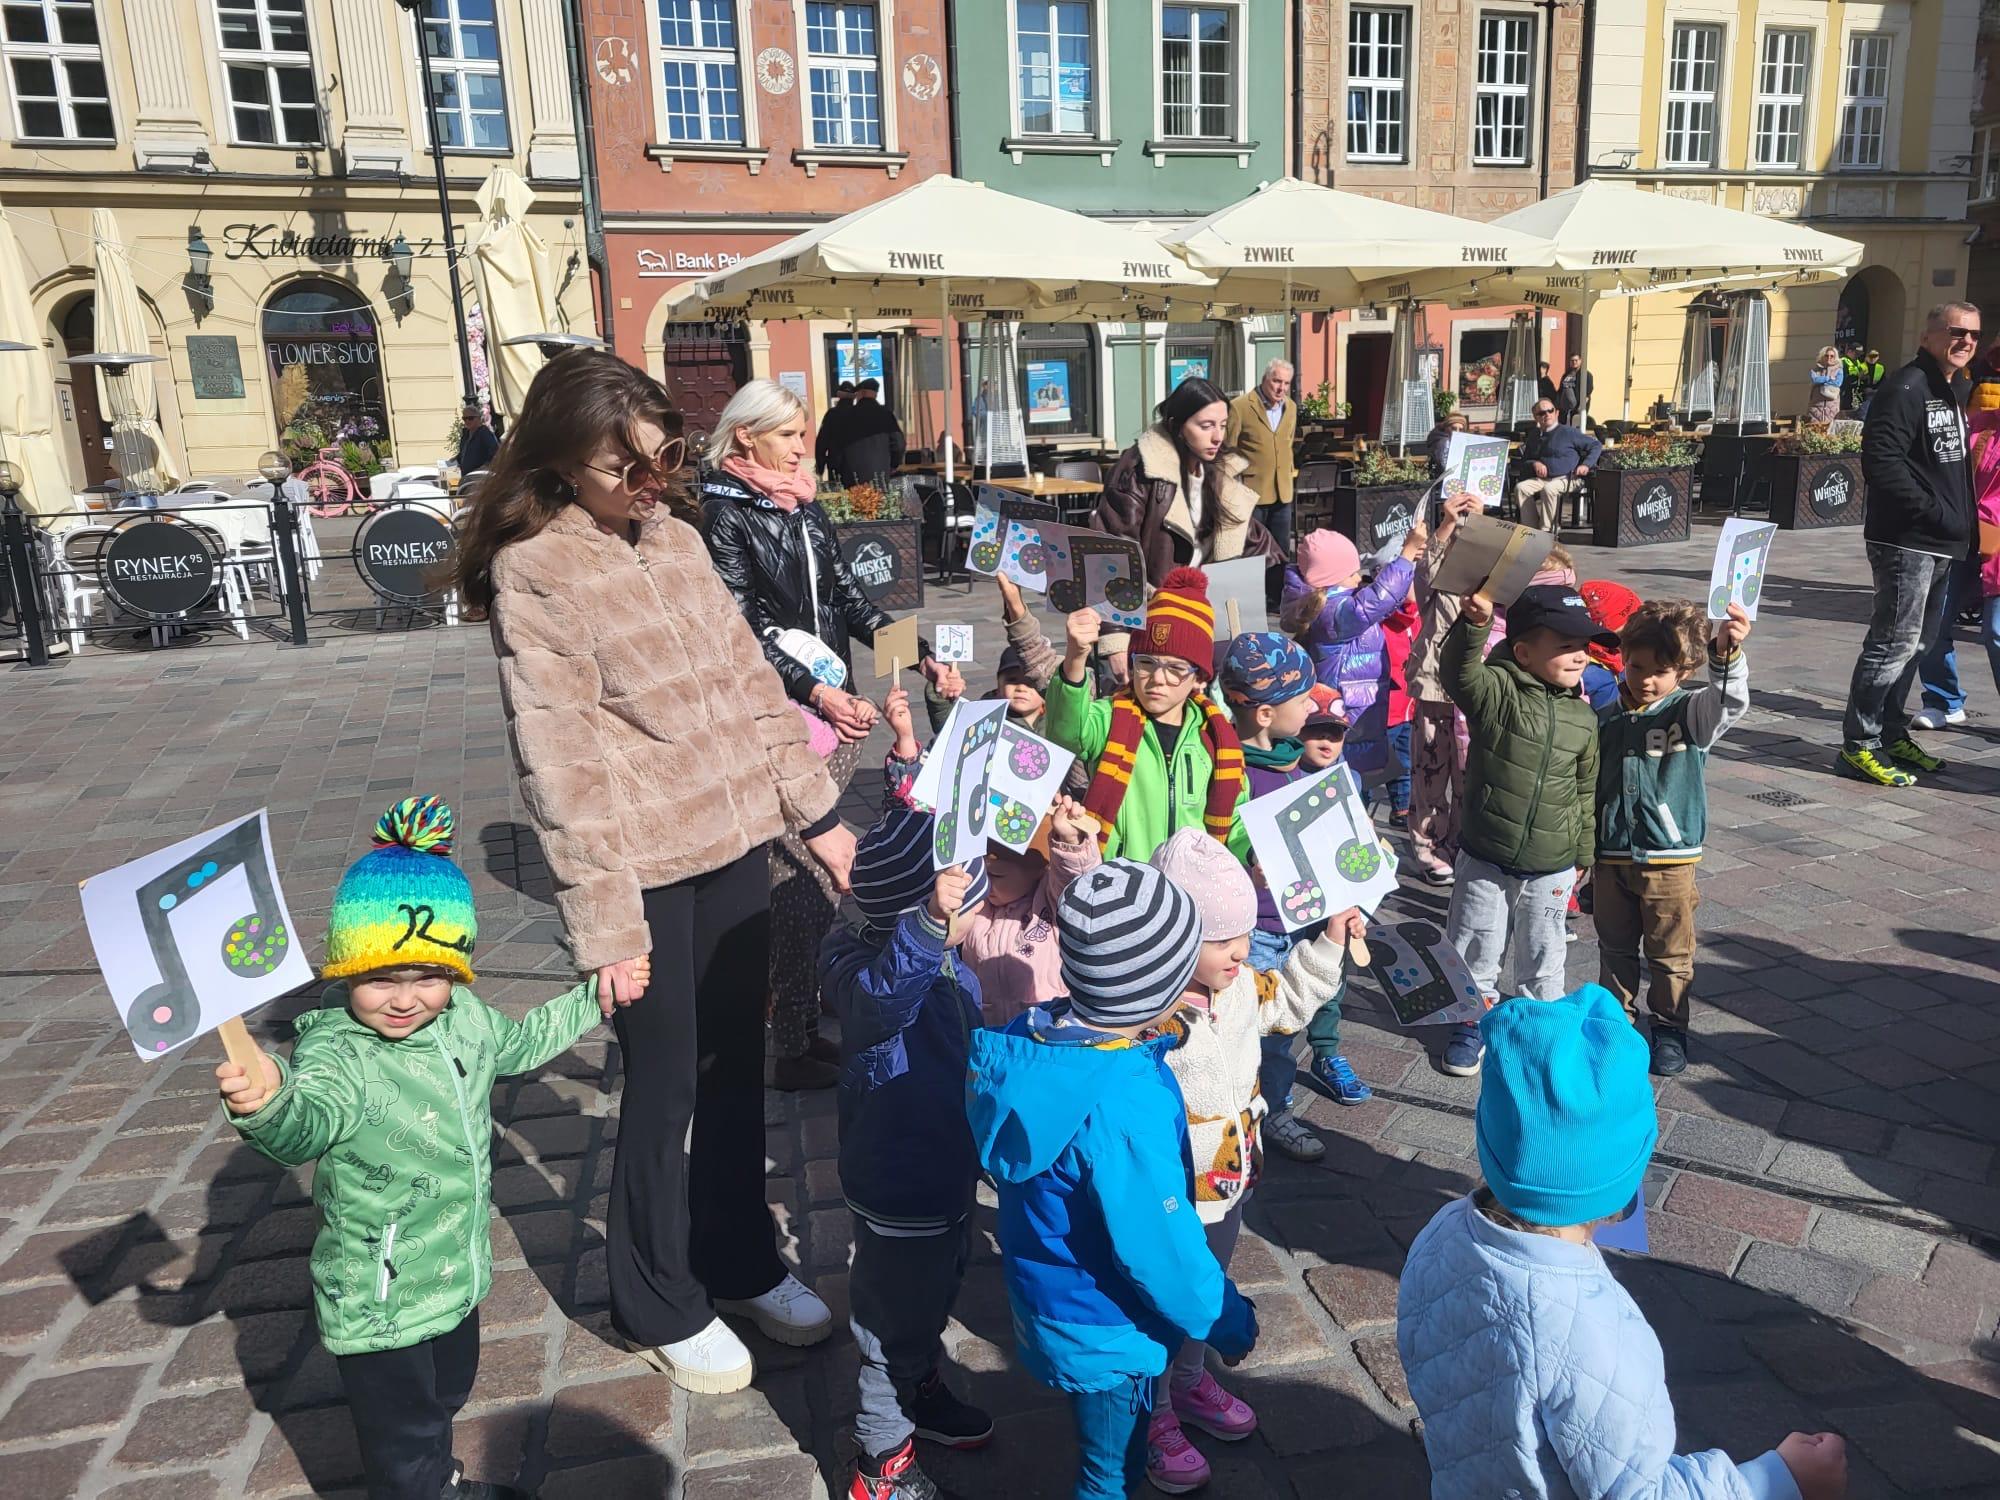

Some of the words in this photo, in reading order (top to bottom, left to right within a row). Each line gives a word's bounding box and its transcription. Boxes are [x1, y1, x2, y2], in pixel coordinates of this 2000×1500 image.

[675, 253, 715, 269] Bank
[888, 250, 945, 270] ŻYWIEC
[1244, 245, 1295, 262] ŻYWIEC
[1462, 245, 1508, 262] ŻYWIEC
[1592, 250, 1638, 265] ŻYWIEC
[1783, 247, 1824, 262] ŻYWIEC
[1122, 261, 1172, 278] ŻYWIEC
[1523, 290, 1561, 307] ŻYWIEC
[267, 342, 336, 364] FLOWER
[338, 342, 378, 364] SHOP
[367, 541, 437, 561] RYNEK
[435, 540, 449, 550] 95
[114, 555, 190, 576] RYNEK
[189, 553, 203, 564] 95
[382, 557, 439, 567] RESTAURACJA
[129, 571, 194, 582] RESTAURACJA
[872, 569, 893, 586] JAR
[1645, 721, 1688, 757] 82
